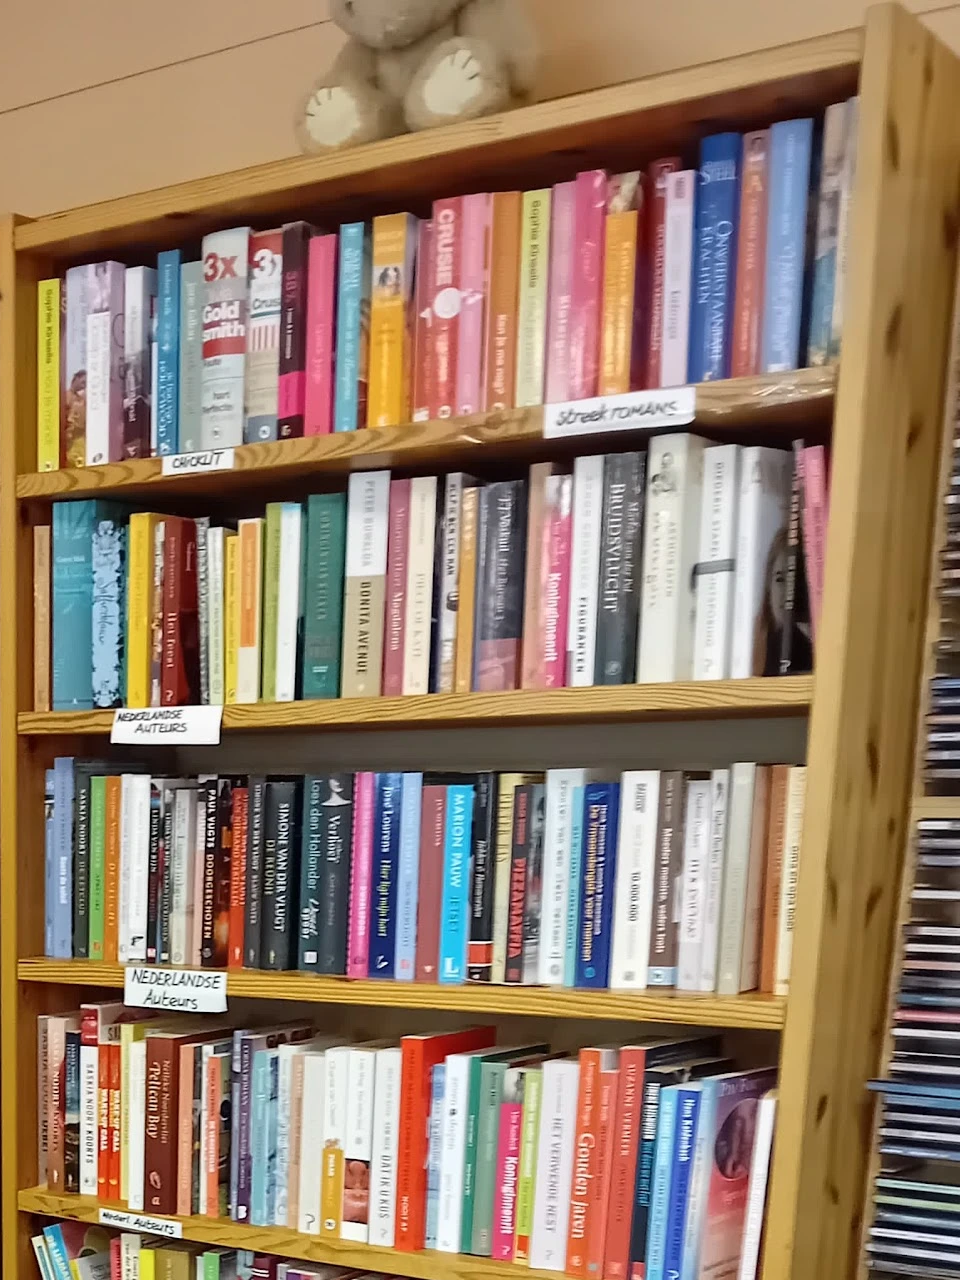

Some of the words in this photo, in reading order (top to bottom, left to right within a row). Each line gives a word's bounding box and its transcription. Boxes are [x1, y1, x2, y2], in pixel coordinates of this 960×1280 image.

[436, 209, 454, 286] CRUSIE
[203, 301, 240, 323] Gold
[359, 582, 370, 625] BONITA
[356, 631, 369, 675] AVENUE
[135, 723, 188, 733] AUTEURS
[78, 788, 88, 822] SASKIA
[207, 789, 217, 814] PAUL
[310, 779, 322, 805] Loes
[206, 816, 216, 848] VUGTS
[277, 803, 290, 845] SIMONE
[310, 809, 322, 830] den
[451, 794, 466, 847] MARION
[77, 824, 87, 855] NOORT
[661, 828, 674, 864] Moeders
[277, 849, 288, 871] VAN
[307, 834, 321, 890] Hollander
[450, 852, 464, 888] PAUW
[203, 854, 214, 939] DOORGESCHOTEN
[276, 873, 287, 893] DER
[786, 886, 798, 906] opa
[274, 896, 286, 932] VLUGT
[132, 969, 222, 989] NEDERLANDSE
[143, 989, 198, 1010] Auteurs
[86, 1064, 95, 1095] SASKIA
[148, 1061, 161, 1111] Pelican
[146, 1115, 160, 1139] Bay
[551, 1117, 563, 1138] HET
[620, 1113, 633, 1157] VERMEER
[381, 1154, 392, 1174] DAT
[575, 1133, 595, 1196] Gouden
[380, 1177, 391, 1187] IK
[379, 1199, 390, 1219] KUS
[571, 1200, 590, 1239] jaren
[133, 1219, 175, 1235] Auteurs
